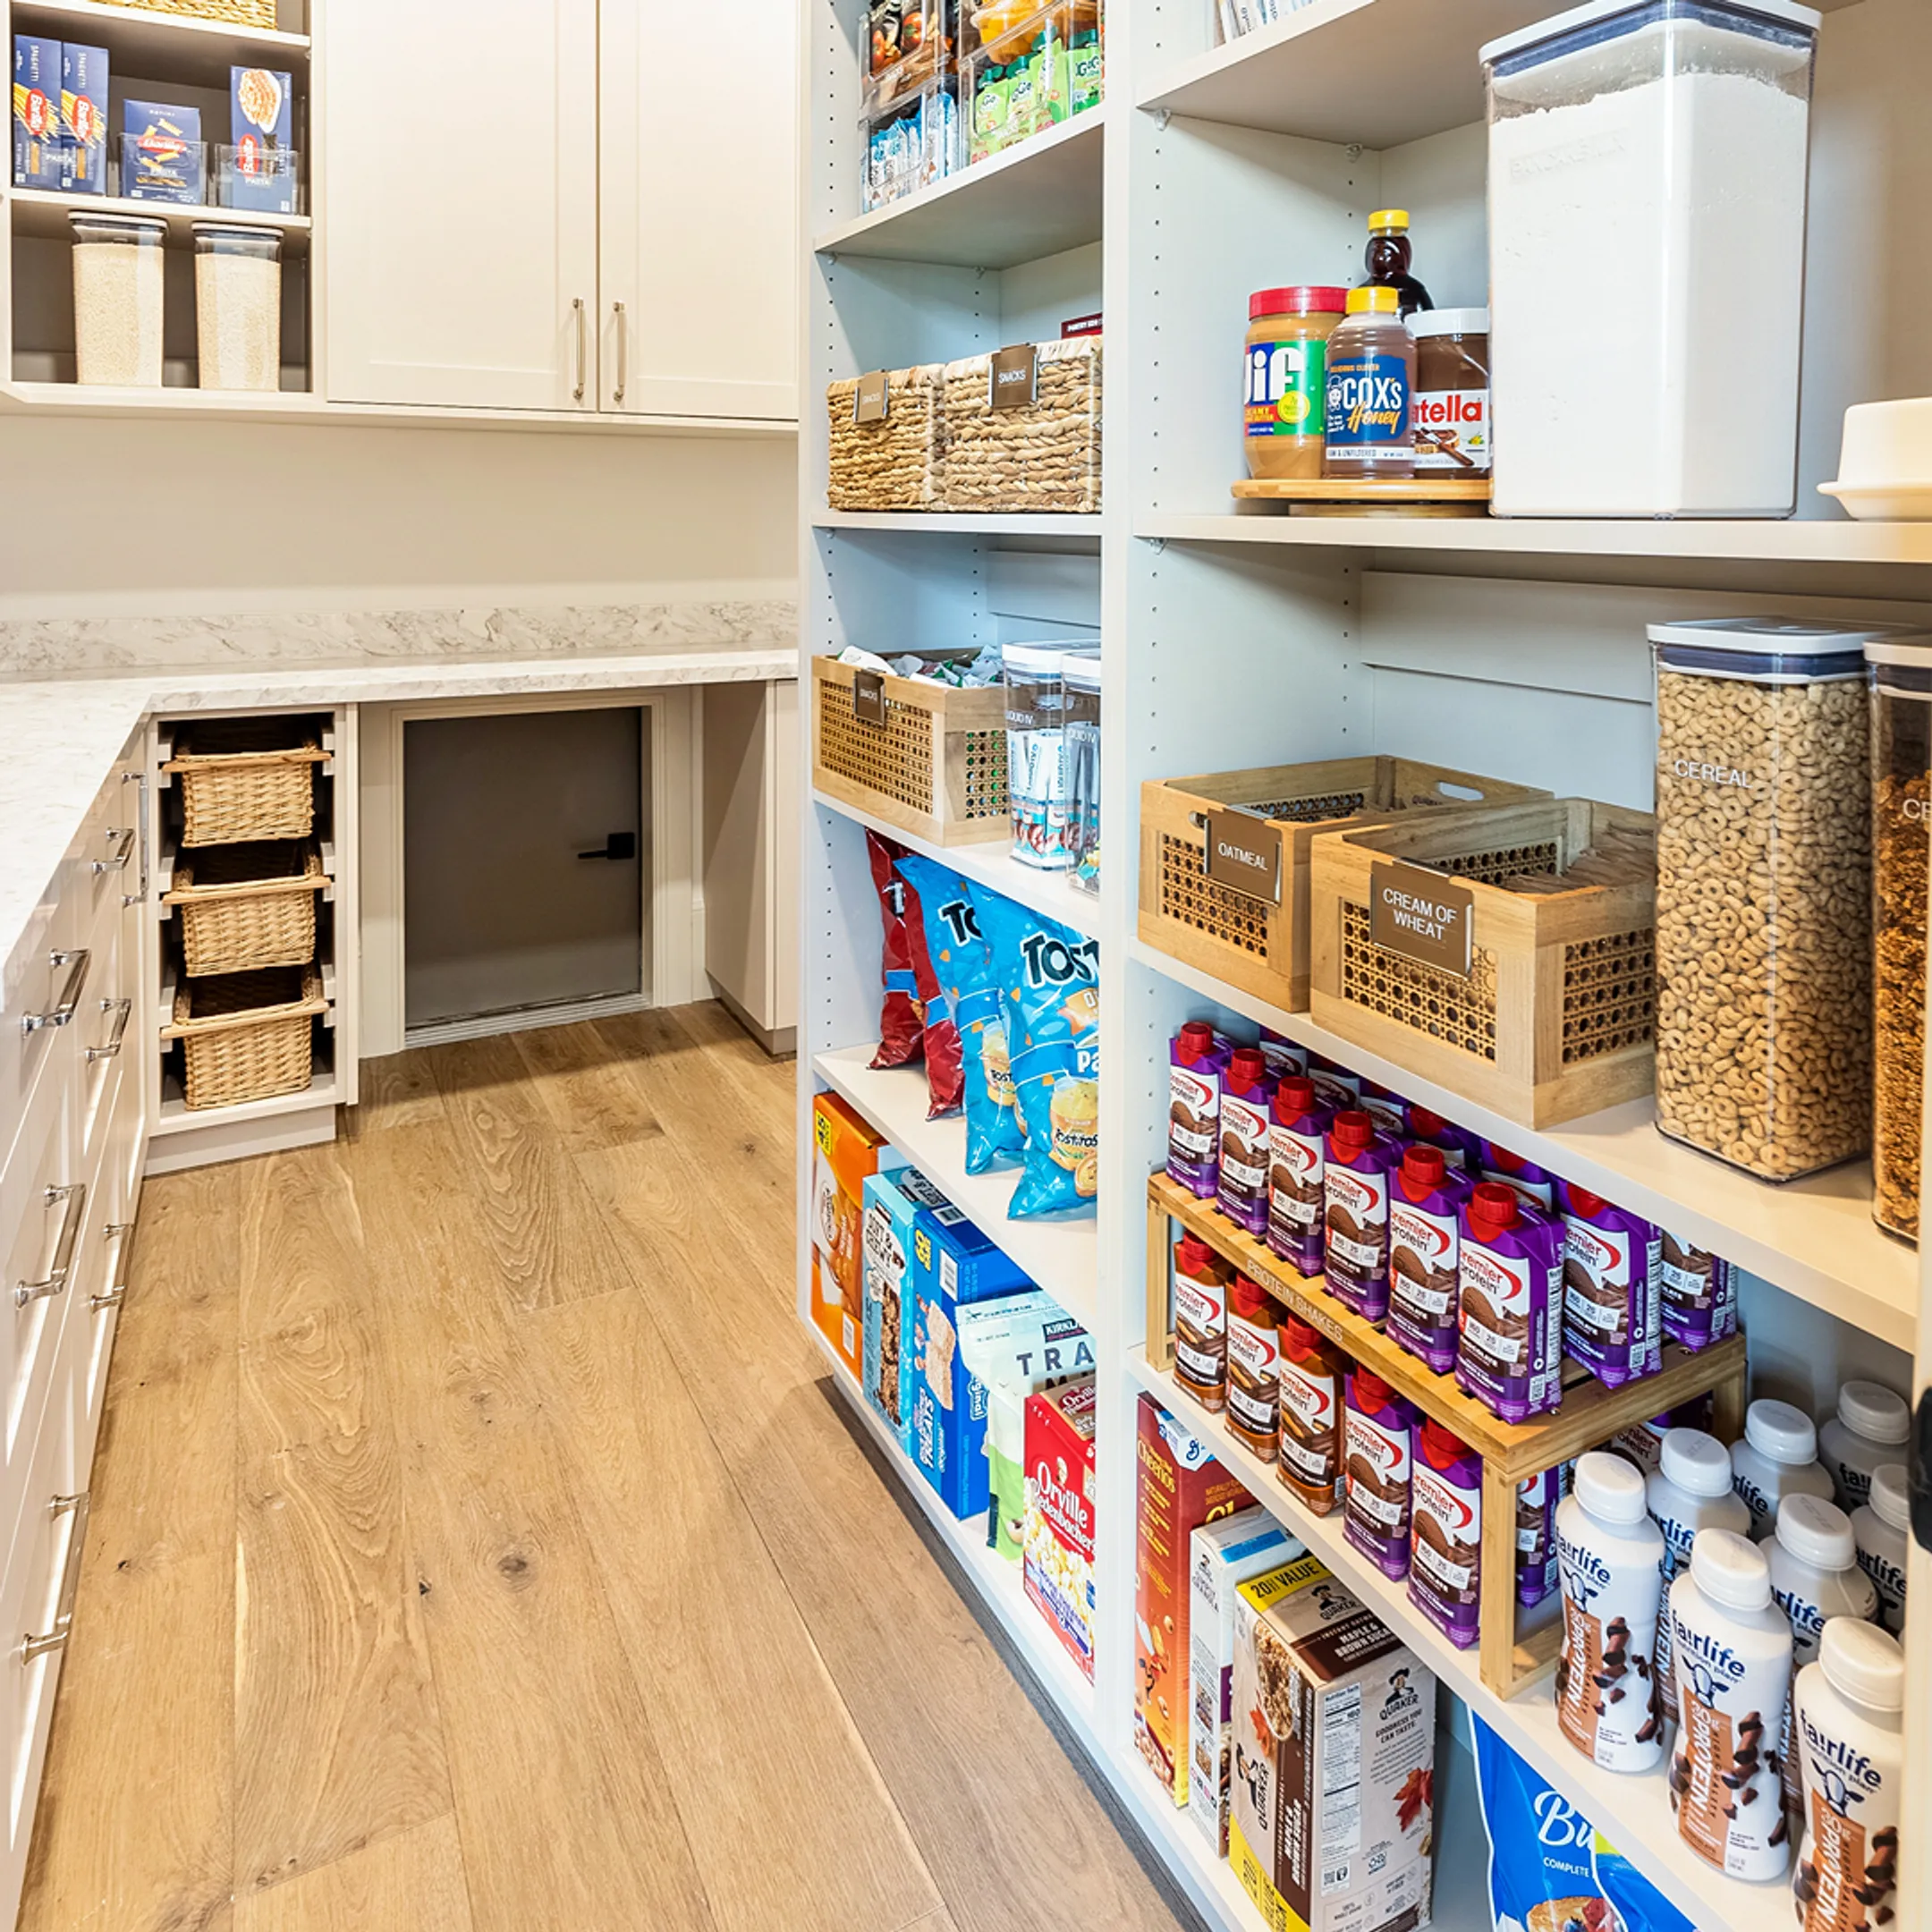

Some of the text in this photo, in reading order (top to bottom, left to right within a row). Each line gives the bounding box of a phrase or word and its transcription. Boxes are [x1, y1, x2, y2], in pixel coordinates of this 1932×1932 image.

[998, 368, 1027, 385] SNACKS
[1347, 401, 1402, 435] Honey
[1674, 759, 1753, 789] CEREAL
[1217, 842, 1267, 872] OATMEAL
[1383, 886, 1457, 925] CREAM OF
[1394, 909, 1445, 942] WHEAT
[1247, 1258, 1295, 1306] PROTEIN
[1297, 1296, 1343, 1342] SHAKES
[1037, 1462, 1088, 1530] Orville
[1250, 1561, 1320, 1599] 20 VALUE
[1319, 1600, 1360, 1621] QUAKER
[1334, 1628, 1393, 1658] BROWN SUGA
[1339, 1625, 1367, 1645] MAPLE
[1672, 1609, 1746, 1678] fairlife
[1566, 1620, 1586, 1708] PROTEIN
[1379, 1693, 1419, 1721] QUAKER
[1689, 1713, 1713, 1818] PROTEIN
[1801, 1708, 1882, 1787] fairlife
[1257, 1761, 1270, 1831] QUAKER
[1543, 1856, 1590, 1878] COMPLETE
[1814, 1819, 1842, 1930] PROTEIN
